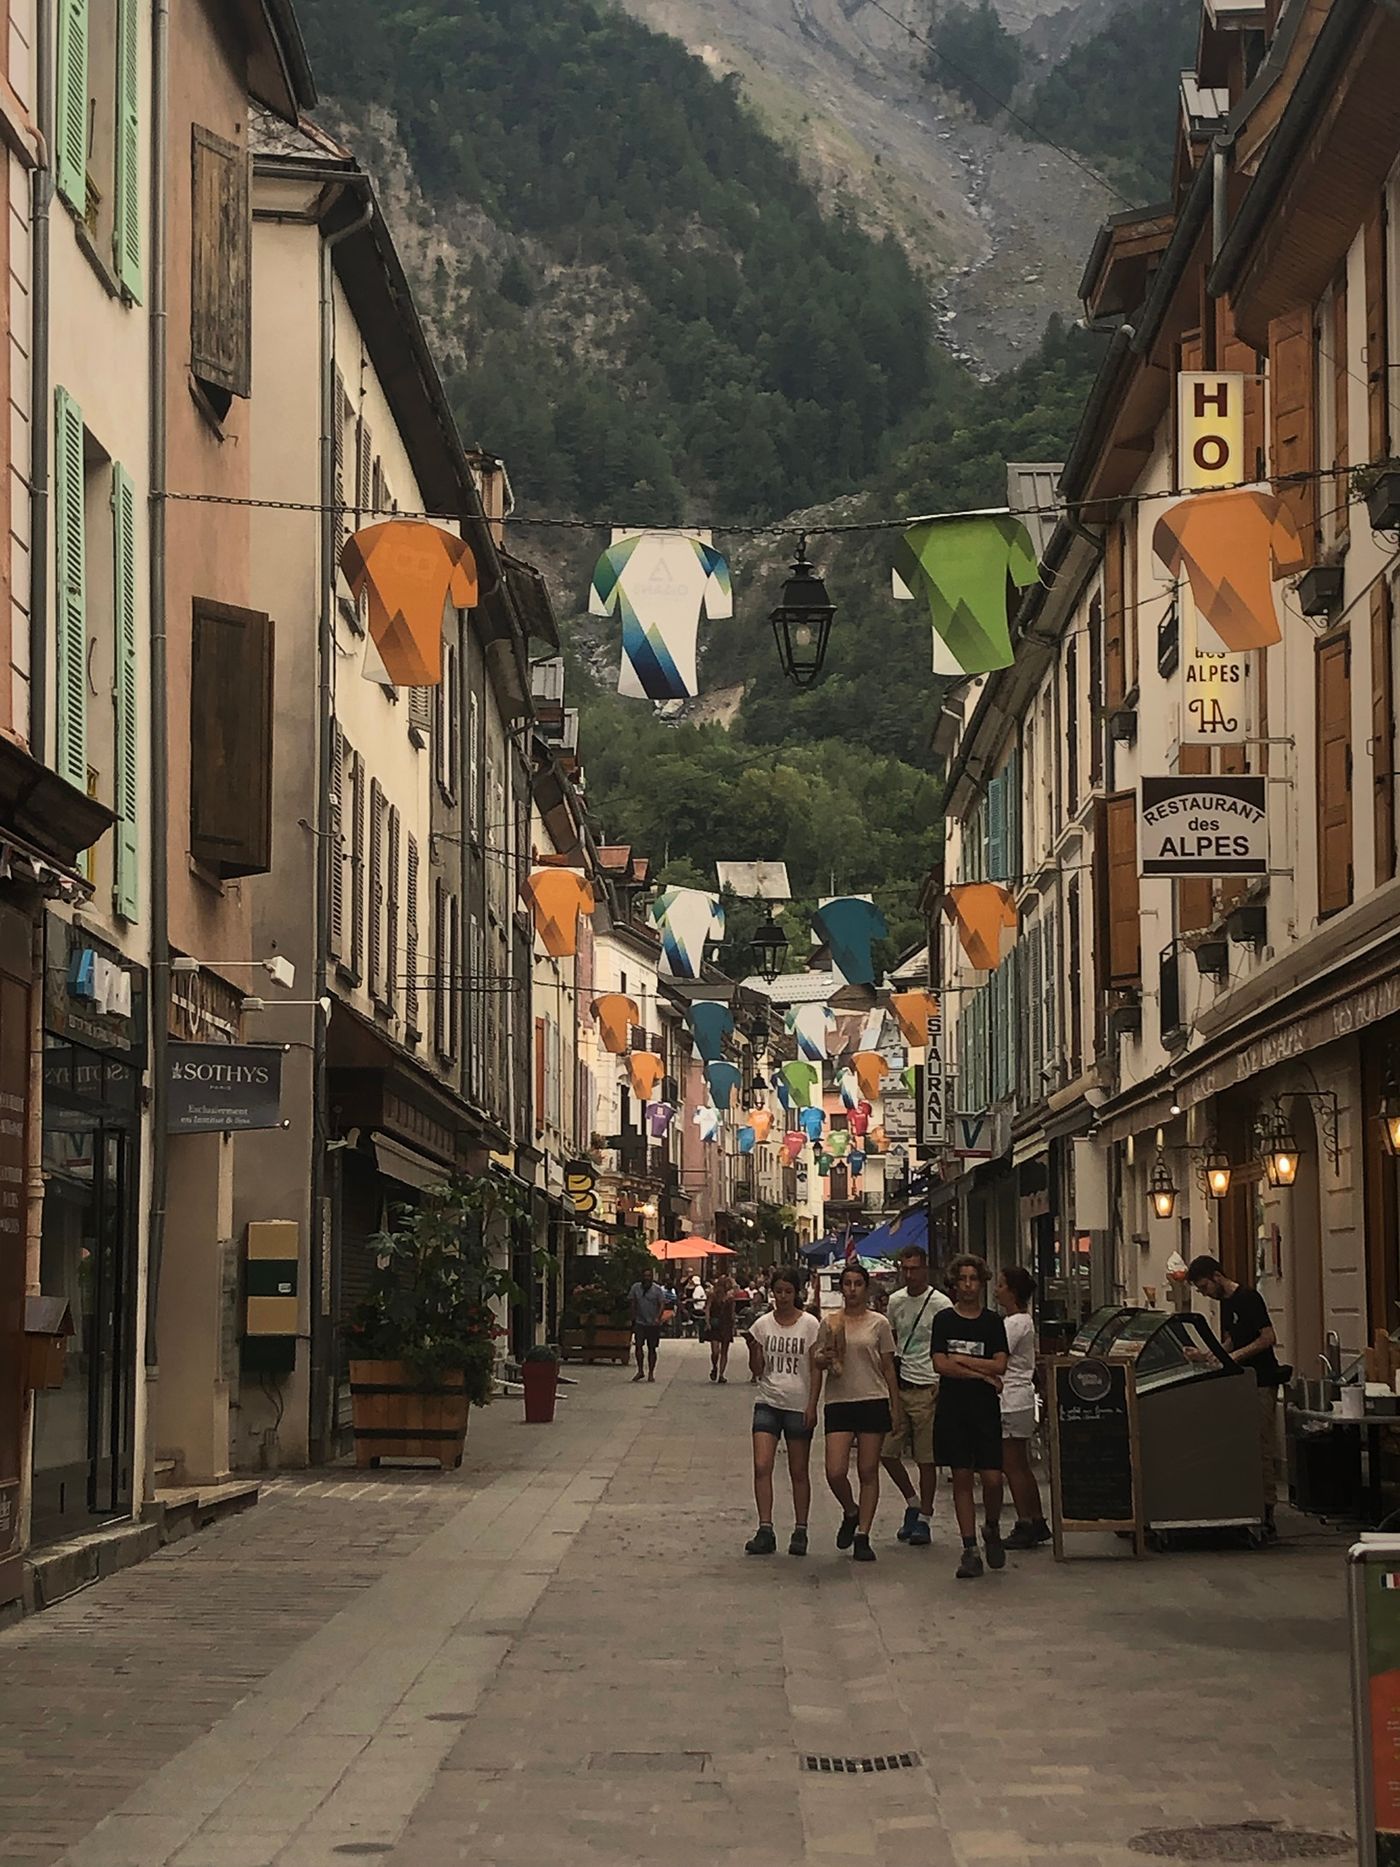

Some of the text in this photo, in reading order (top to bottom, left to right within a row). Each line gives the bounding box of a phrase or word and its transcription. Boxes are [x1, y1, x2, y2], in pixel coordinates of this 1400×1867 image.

[1186, 664, 1240, 683] ALPES
[1142, 796, 1266, 826] RESTAURANT
[1187, 816, 1220, 833] des
[1158, 836, 1250, 858] ALPES
[183, 1062, 269, 1084] SOTHYS
